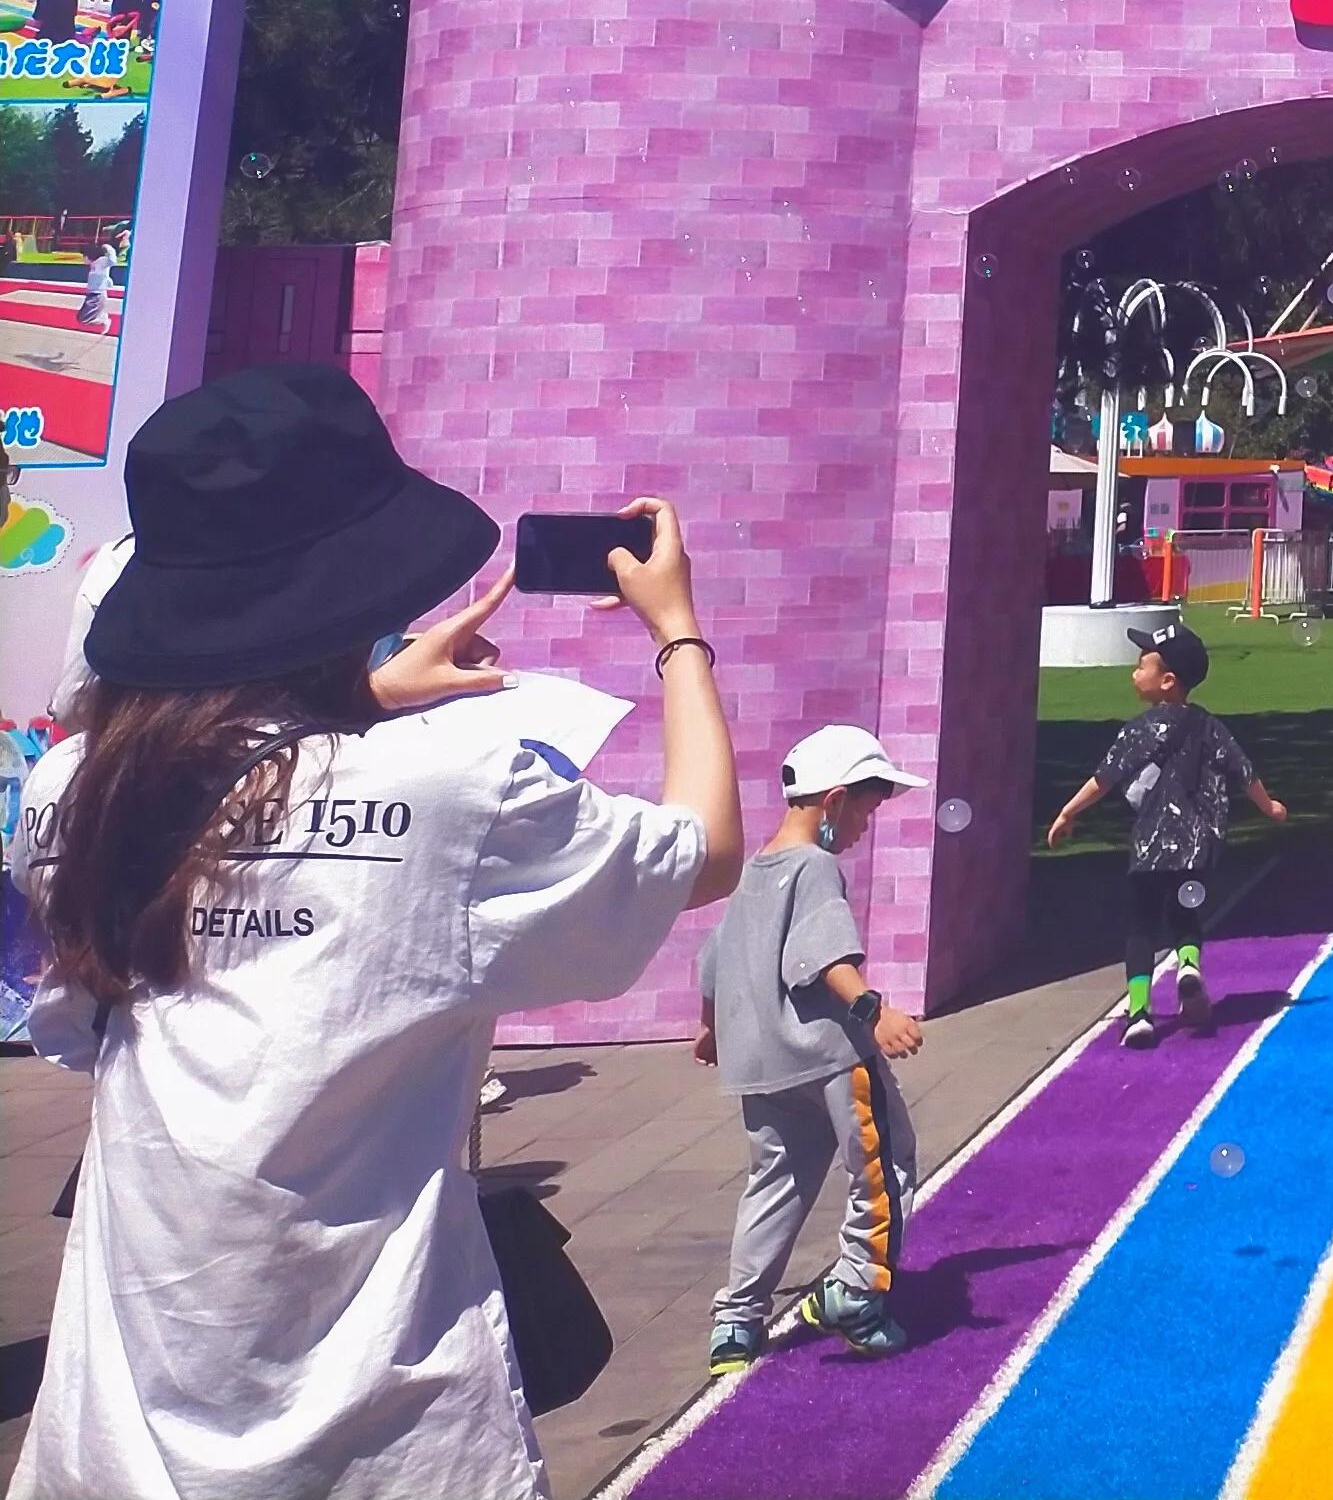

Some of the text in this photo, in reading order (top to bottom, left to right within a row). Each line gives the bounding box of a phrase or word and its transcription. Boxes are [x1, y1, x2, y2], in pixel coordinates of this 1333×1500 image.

[0, 39, 128, 77] 龙大战
[304, 798, 412, 848] 1510
[191, 906, 315, 938] DETAILS
